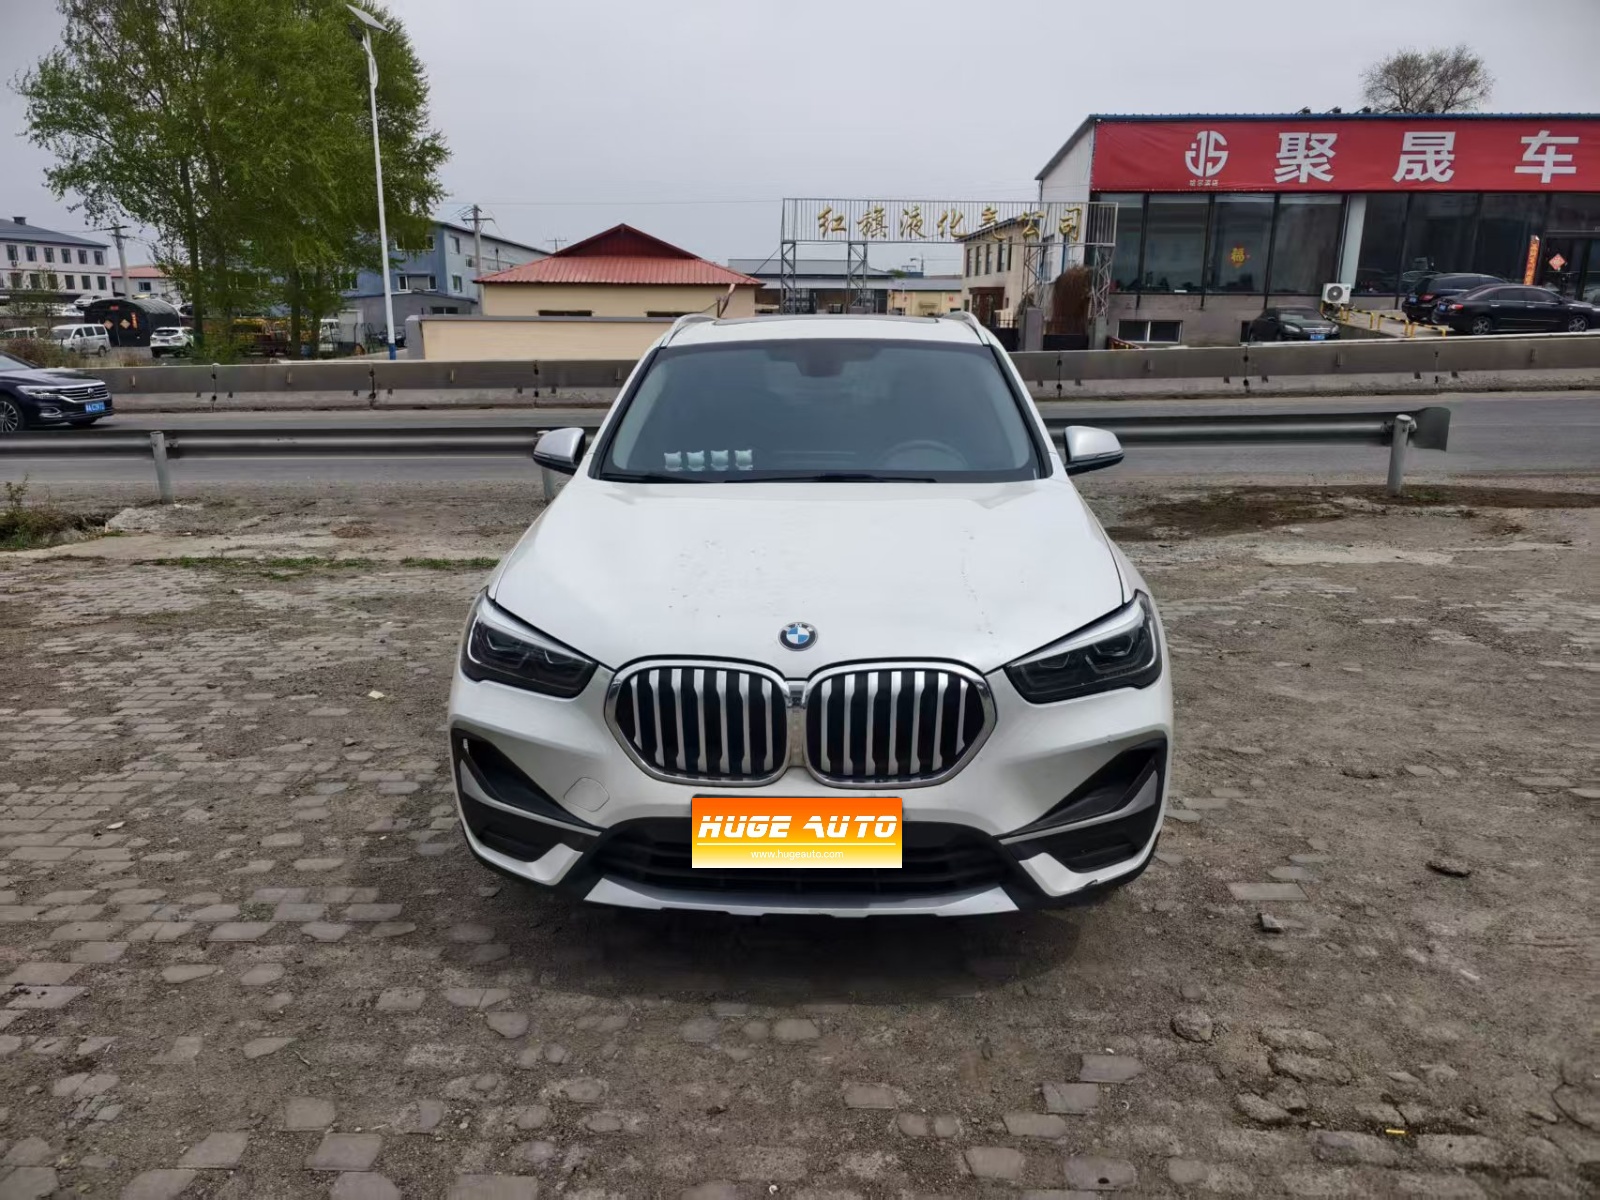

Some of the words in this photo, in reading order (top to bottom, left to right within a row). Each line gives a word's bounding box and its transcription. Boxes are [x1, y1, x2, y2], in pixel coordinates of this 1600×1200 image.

[1273, 130, 1580, 184] 聚晟车
[817, 204, 1083, 242] 红旗液化气公司
